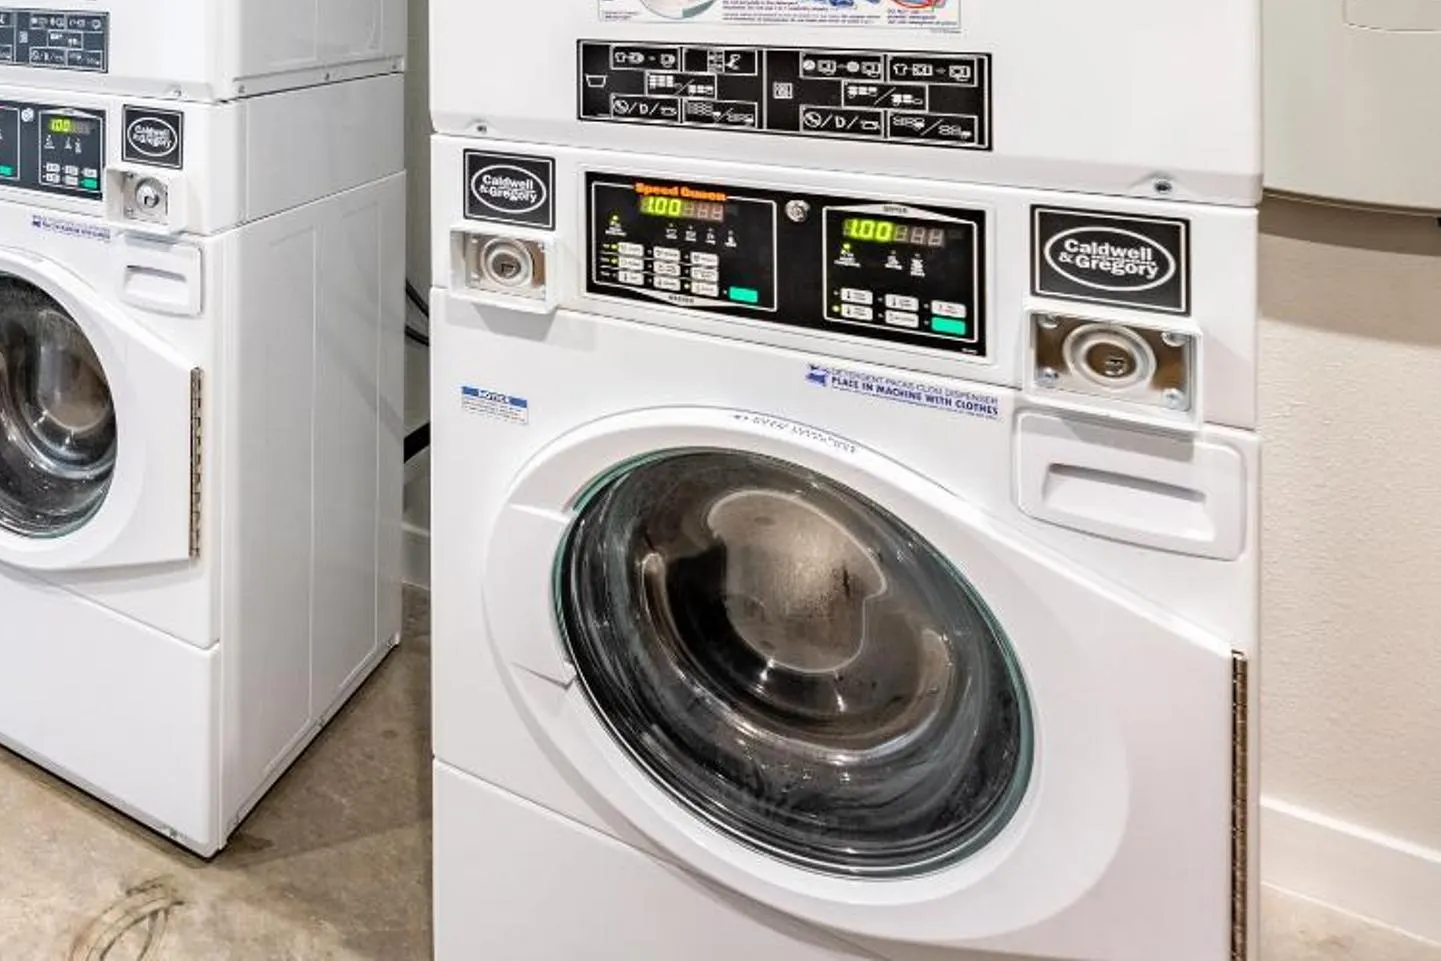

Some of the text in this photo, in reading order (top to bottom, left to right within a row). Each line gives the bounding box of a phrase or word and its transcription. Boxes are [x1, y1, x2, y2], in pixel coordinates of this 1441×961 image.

[482, 174, 534, 191] Caldwell
[635, 183, 726, 201] Speed Queen
[1064, 238, 1153, 261] Caldwell
[1075, 254, 1159, 280] Gregory
[832, 376, 998, 415] PLACE IN MACHINE WITH CLOTHES
